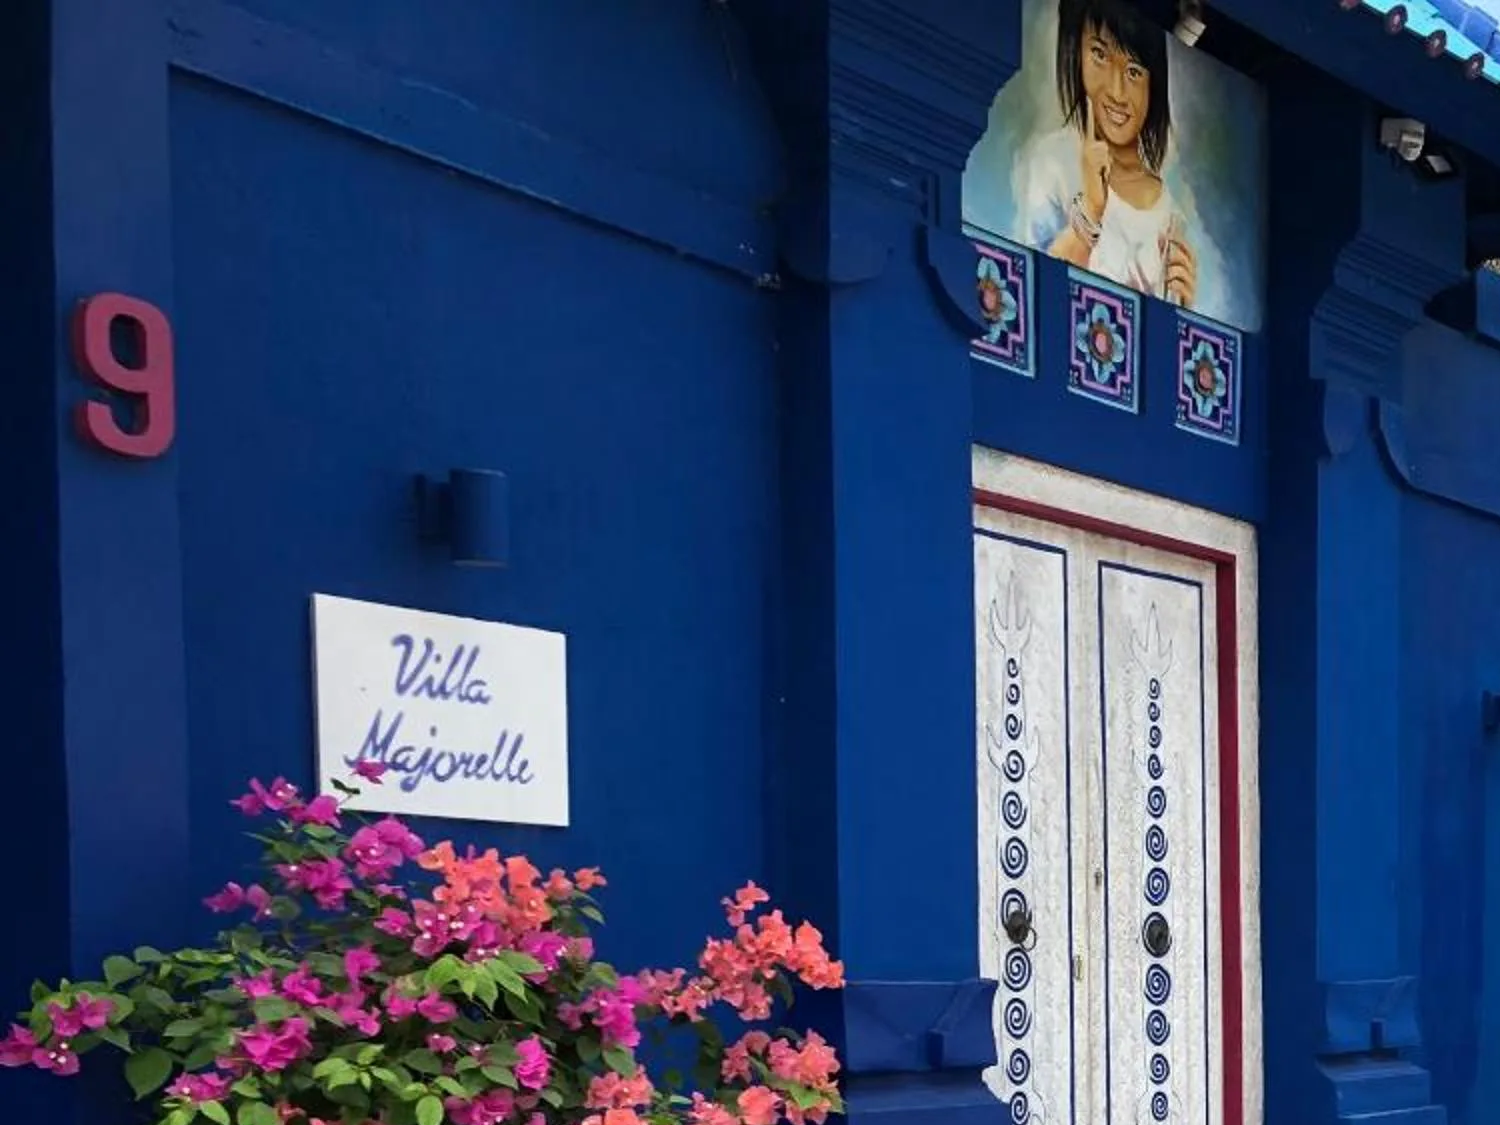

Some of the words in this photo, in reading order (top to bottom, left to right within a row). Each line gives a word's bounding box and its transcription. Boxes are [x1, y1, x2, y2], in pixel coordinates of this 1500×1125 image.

[78, 291, 175, 457] 9
[391, 634, 491, 704] Villa
[344, 709, 534, 792] Majorelle
